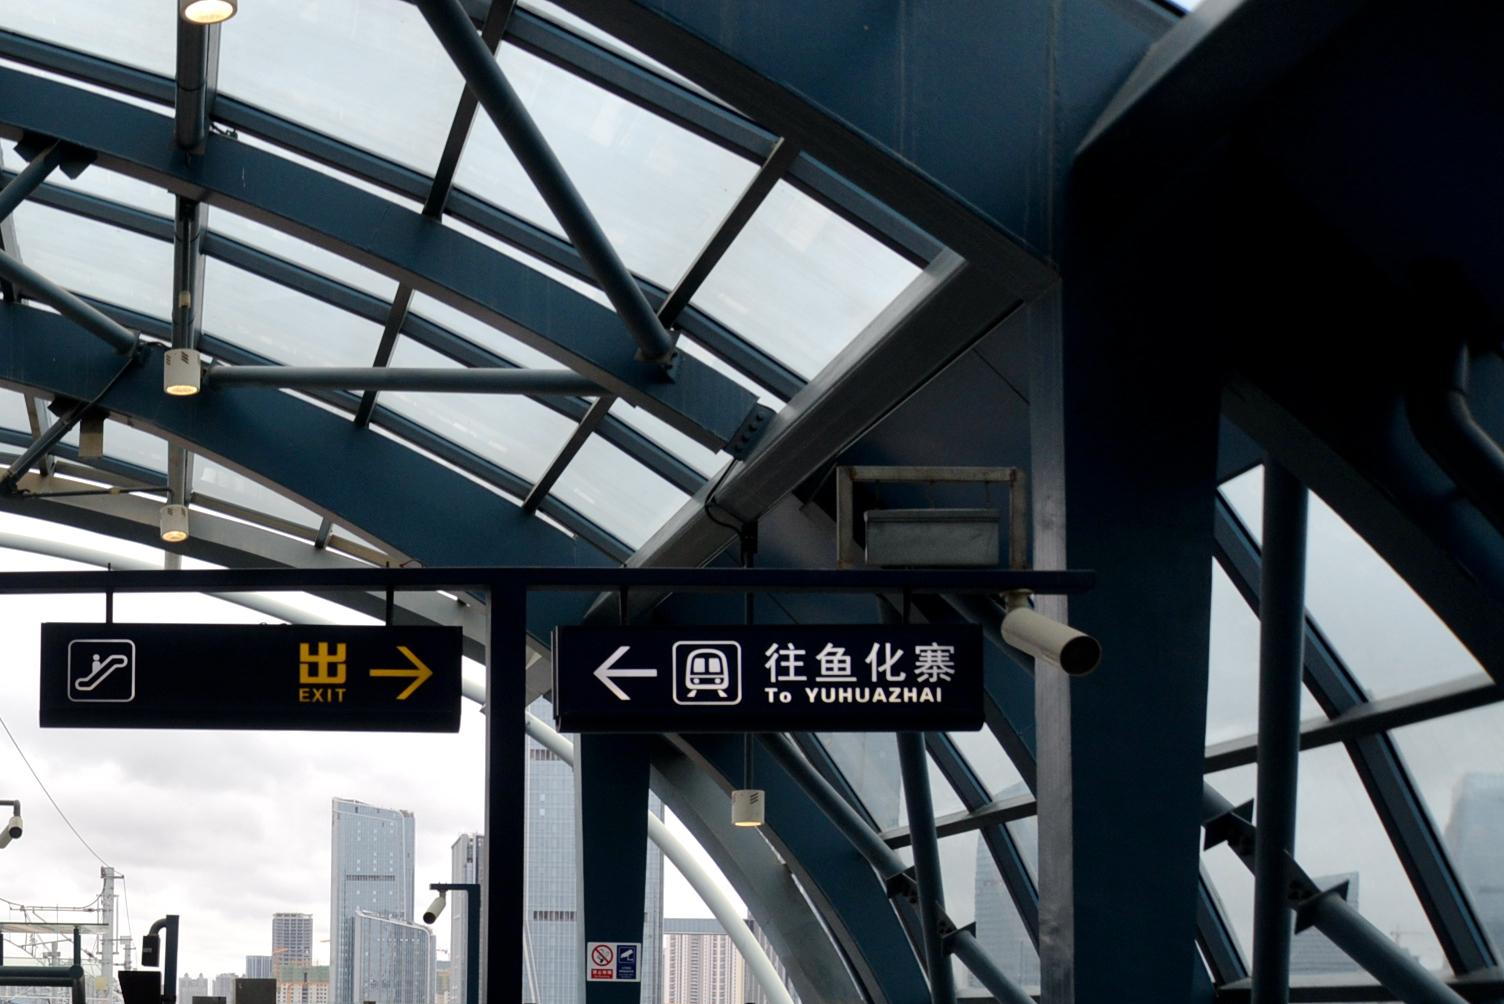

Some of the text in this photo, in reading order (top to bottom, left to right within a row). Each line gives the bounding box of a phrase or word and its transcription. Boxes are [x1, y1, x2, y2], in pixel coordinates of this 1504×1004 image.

[763, 641, 957, 684] 往鱼化寨
[299, 688, 346, 703] EXIT
[764, 687, 942, 703] To YUHUAZHAI
